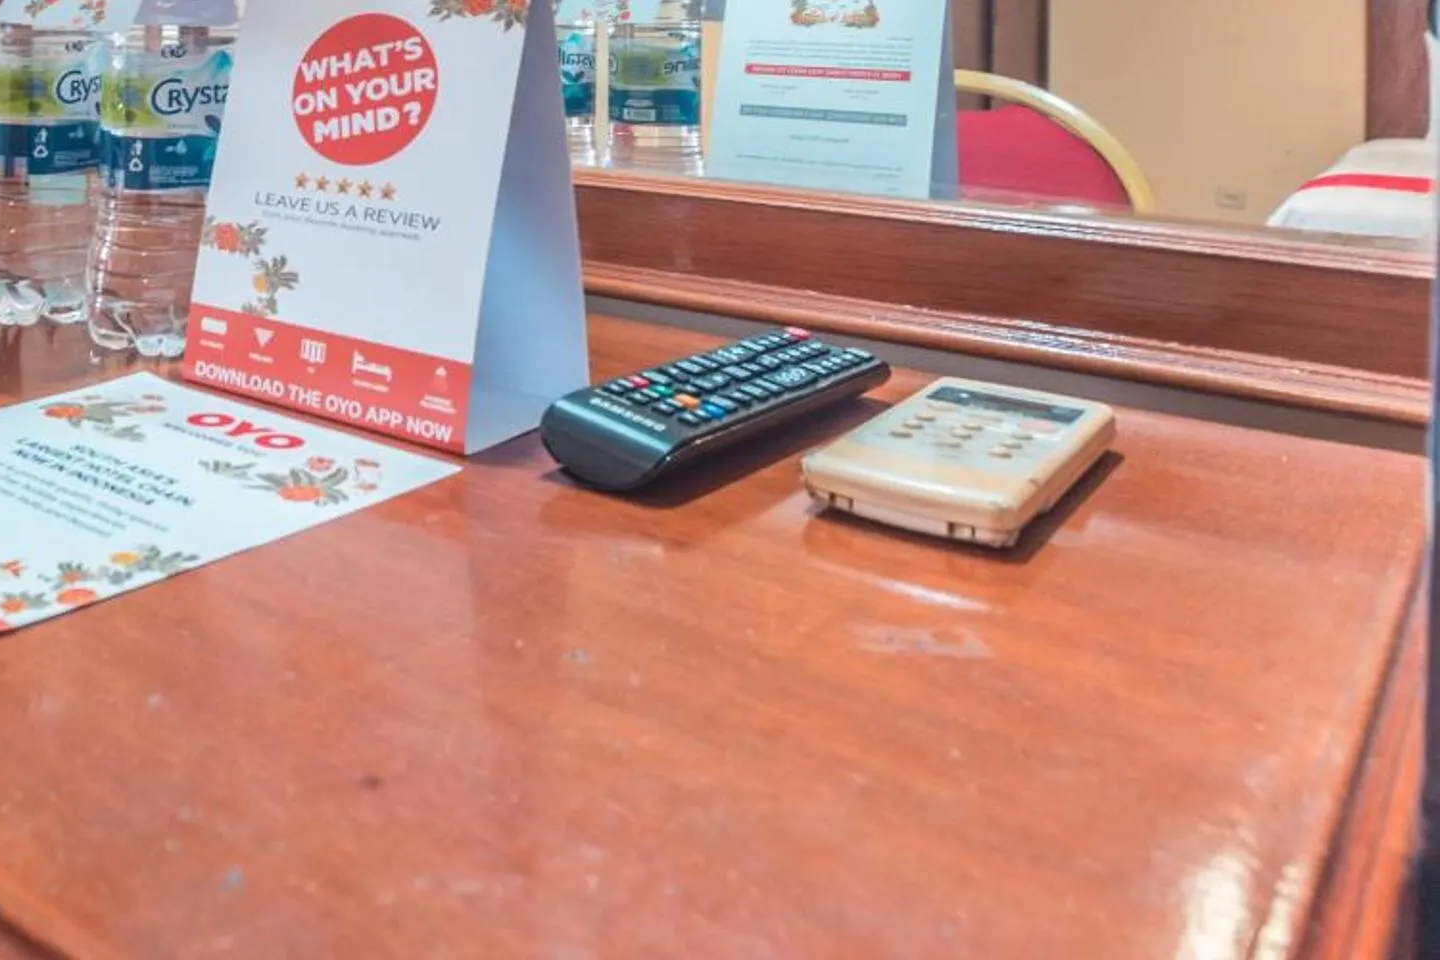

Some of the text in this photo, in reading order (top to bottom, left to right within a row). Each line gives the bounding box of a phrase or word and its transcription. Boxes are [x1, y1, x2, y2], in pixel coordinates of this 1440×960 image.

[300, 36, 424, 83] WHAT'S
[294, 67, 436, 116] ON YOUR
[254, 190, 441, 231] LEAVE US A REVIEW
[194, 360, 286, 398] DOWNLOAD
[287, 383, 322, 409] THE
[325, 395, 362, 420] OYO
[365, 405, 405, 427] APP
[406, 415, 453, 443] NOW
[589, 396, 666, 432] SAMSUNG
[186, 412, 306, 449] OYO
